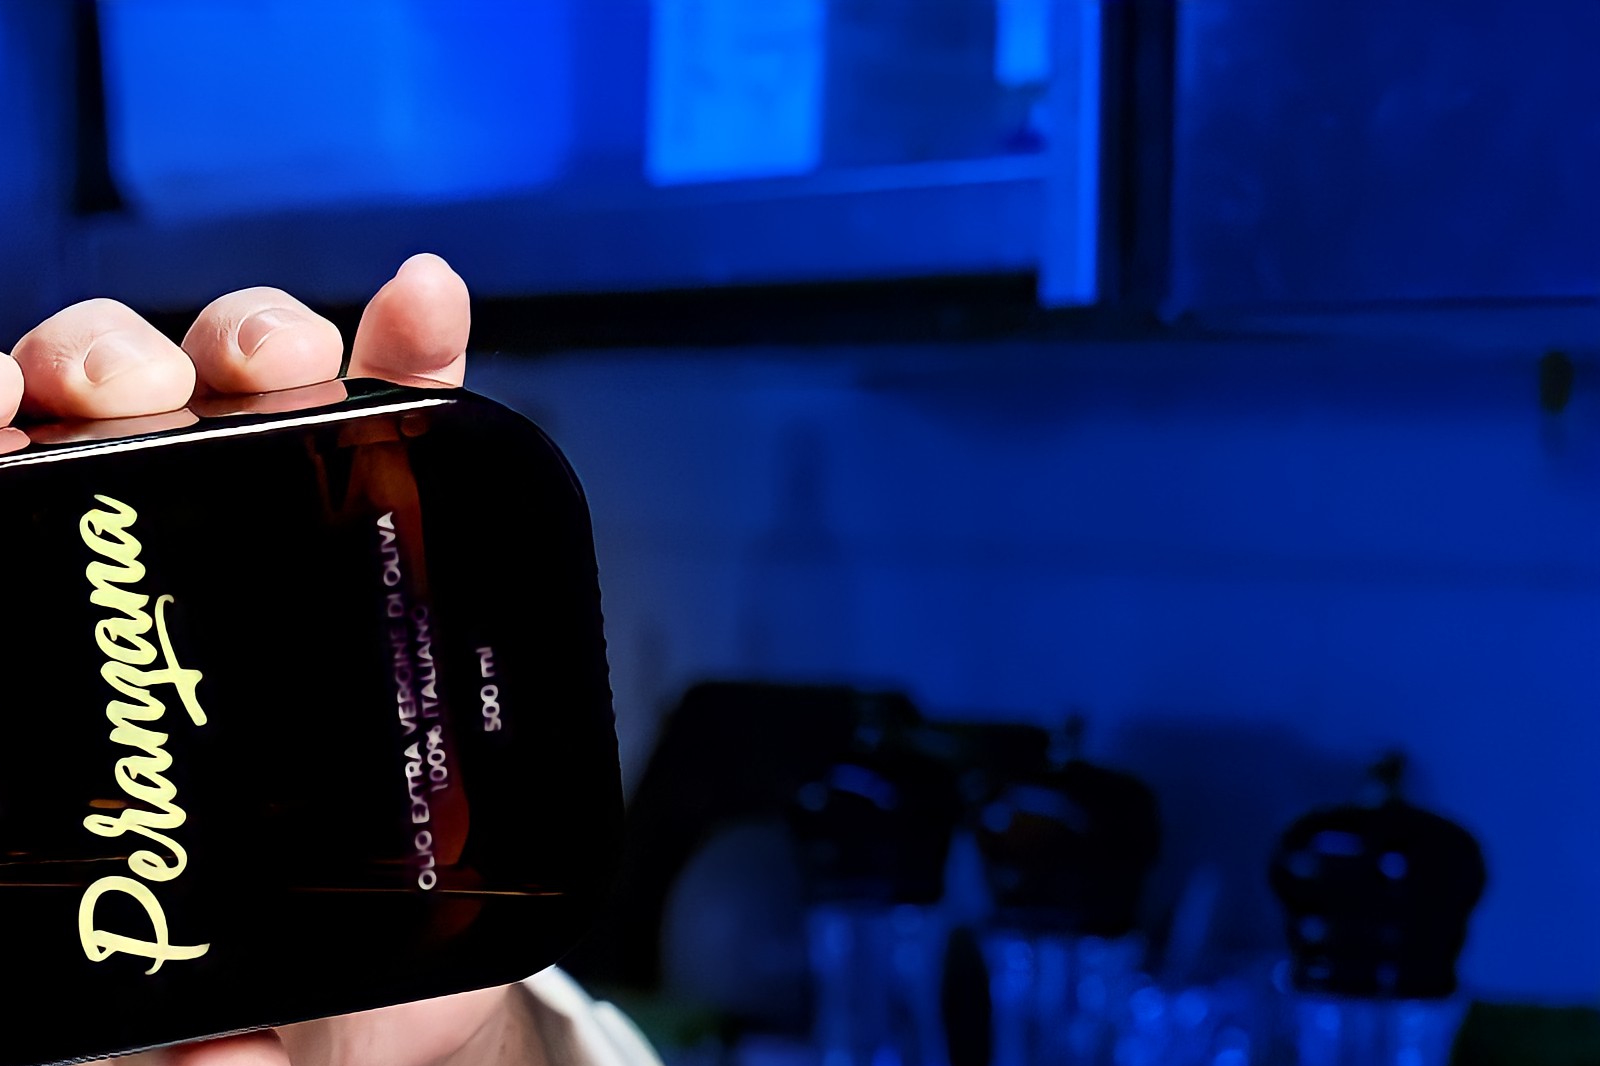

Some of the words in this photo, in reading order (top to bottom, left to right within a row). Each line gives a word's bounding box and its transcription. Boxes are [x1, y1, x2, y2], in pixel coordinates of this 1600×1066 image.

[376, 511, 402, 587] OLIVA
[386, 593, 404, 618] DI
[389, 622, 417, 736] VERGINE
[412, 604, 439, 718] ITALIANO
[476, 646, 497, 678] ml
[79, 494, 211, 975] Peranzana
[480, 684, 503, 732] 500
[404, 741, 430, 824] EXTRA
[424, 724, 449, 793] 100%
[414, 830, 438, 891] OLIO
